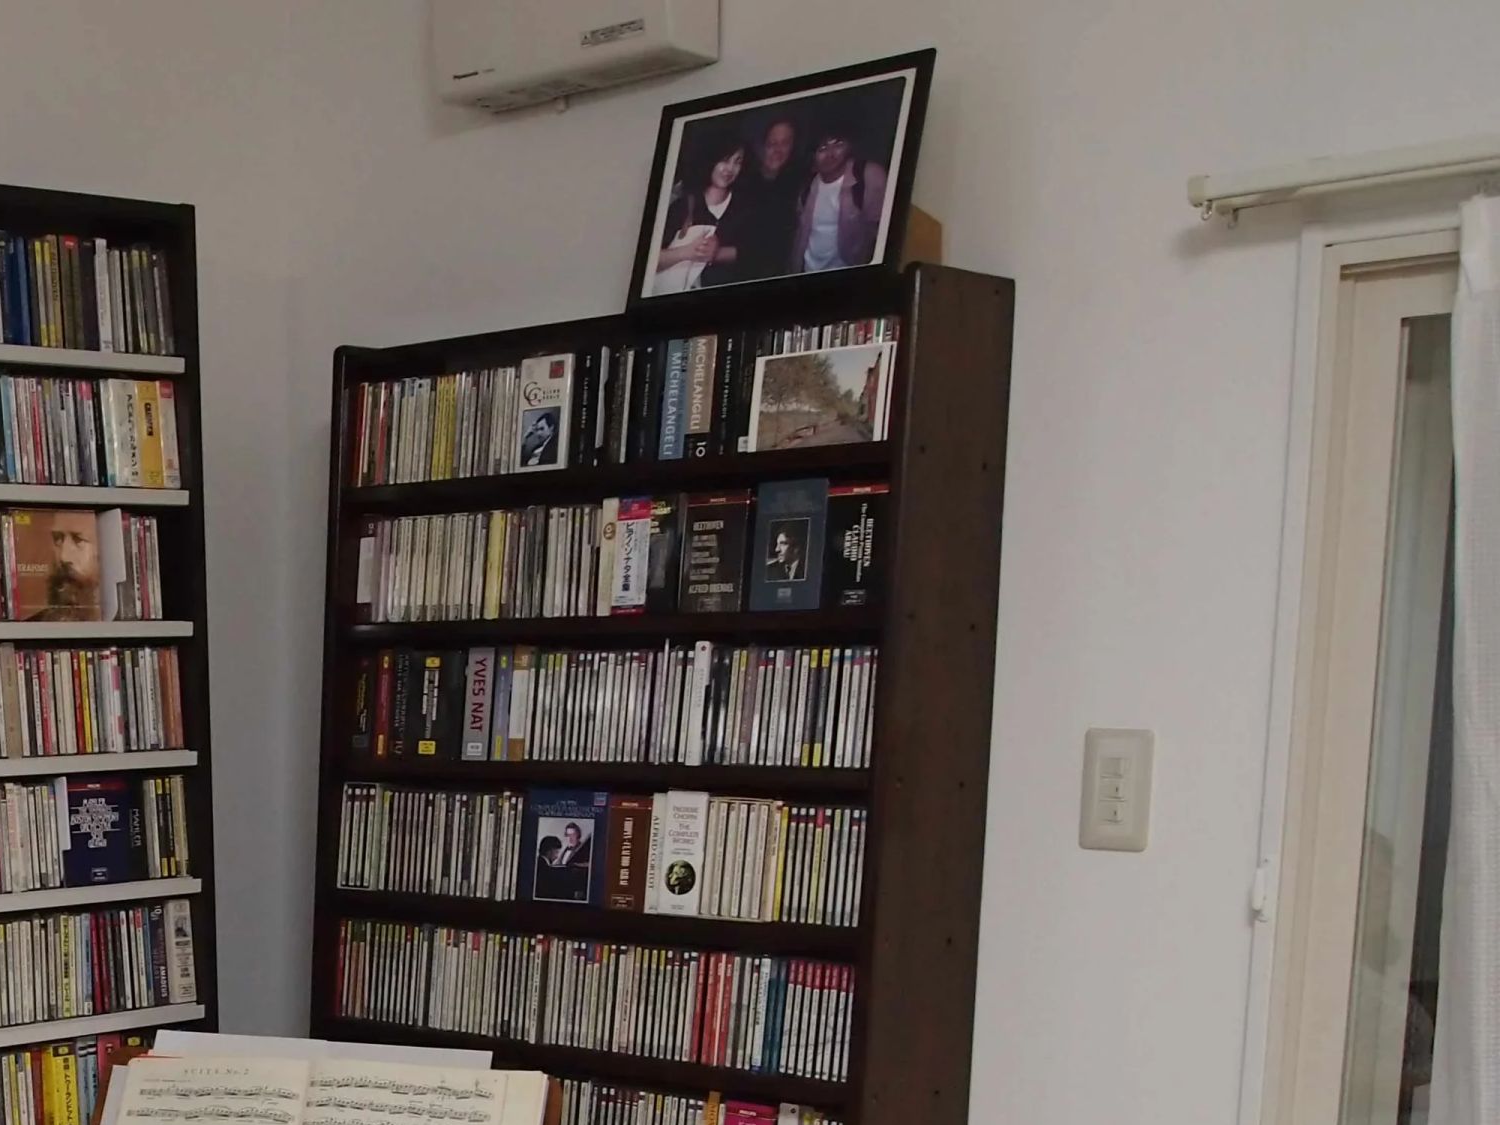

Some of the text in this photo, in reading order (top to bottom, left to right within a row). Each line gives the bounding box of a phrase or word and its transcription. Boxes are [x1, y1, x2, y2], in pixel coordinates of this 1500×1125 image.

[662, 351, 683, 457] MICHELANGELI
[688, 338, 707, 432] MICHELANGELI
[470, 657, 488, 732] YVES NAT
